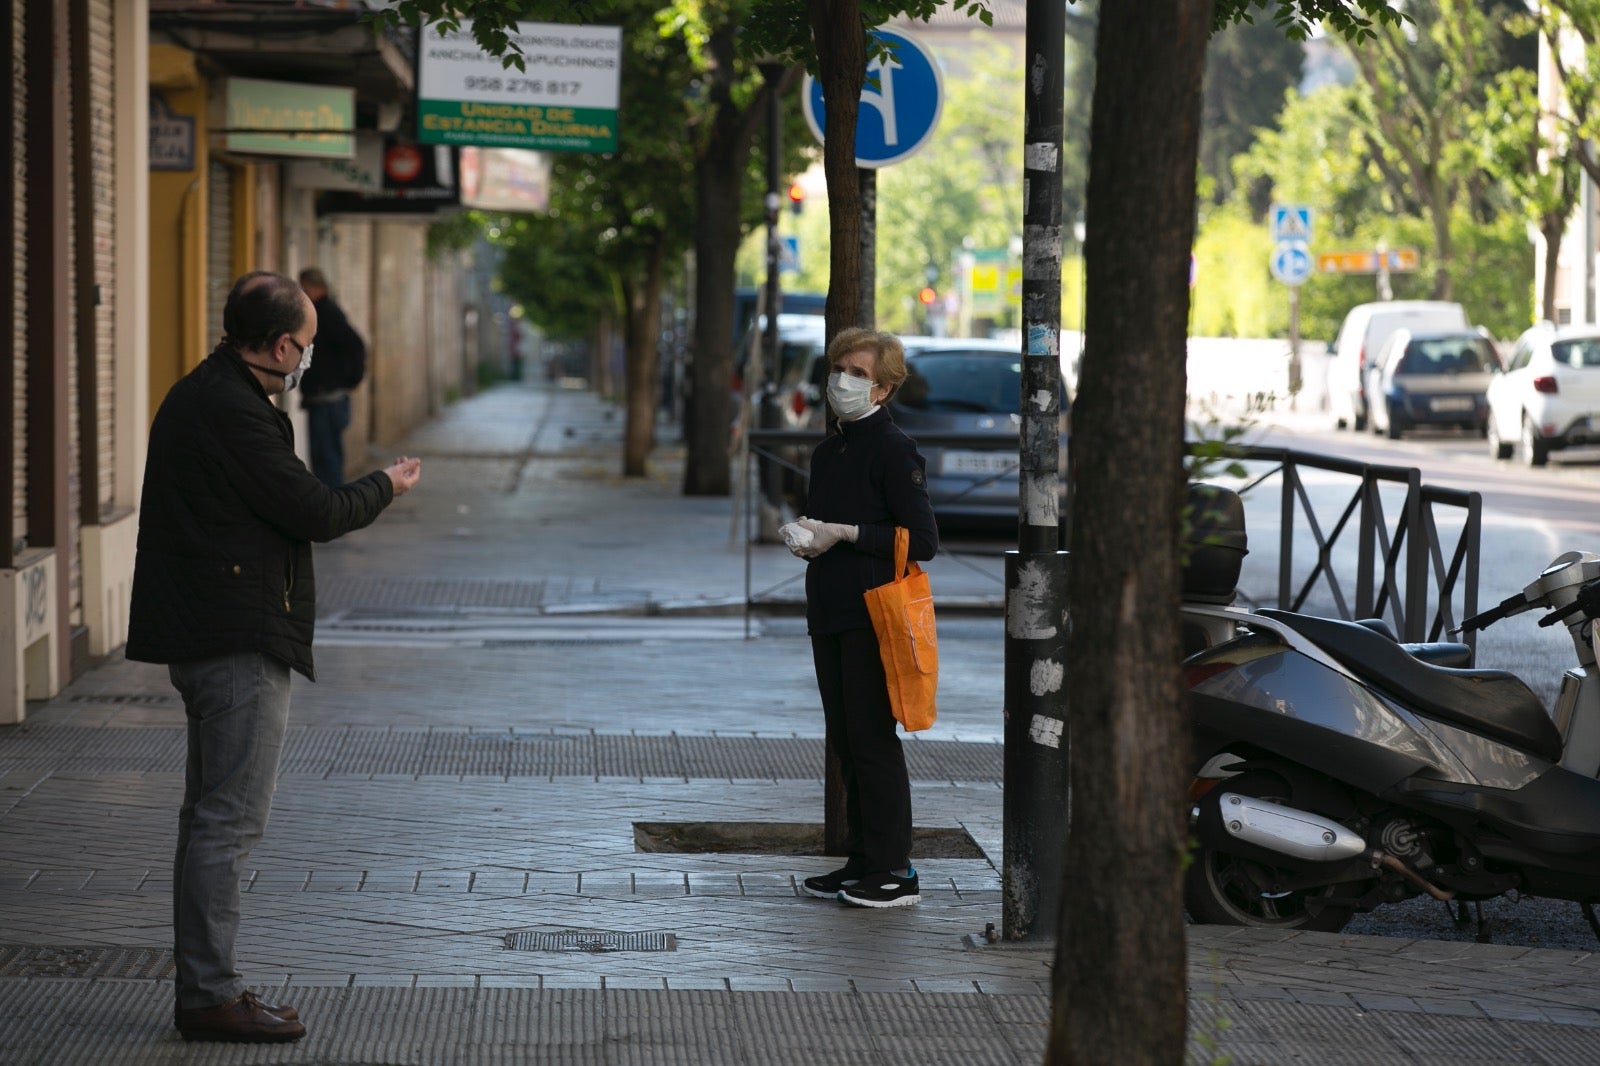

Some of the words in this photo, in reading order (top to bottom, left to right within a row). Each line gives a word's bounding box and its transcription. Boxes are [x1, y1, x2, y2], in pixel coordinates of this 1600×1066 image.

[524, 53, 616, 69] APUCHINOS
[463, 75, 501, 91] 958
[506, 78, 542, 94] 276
[547, 80, 581, 96] 817
